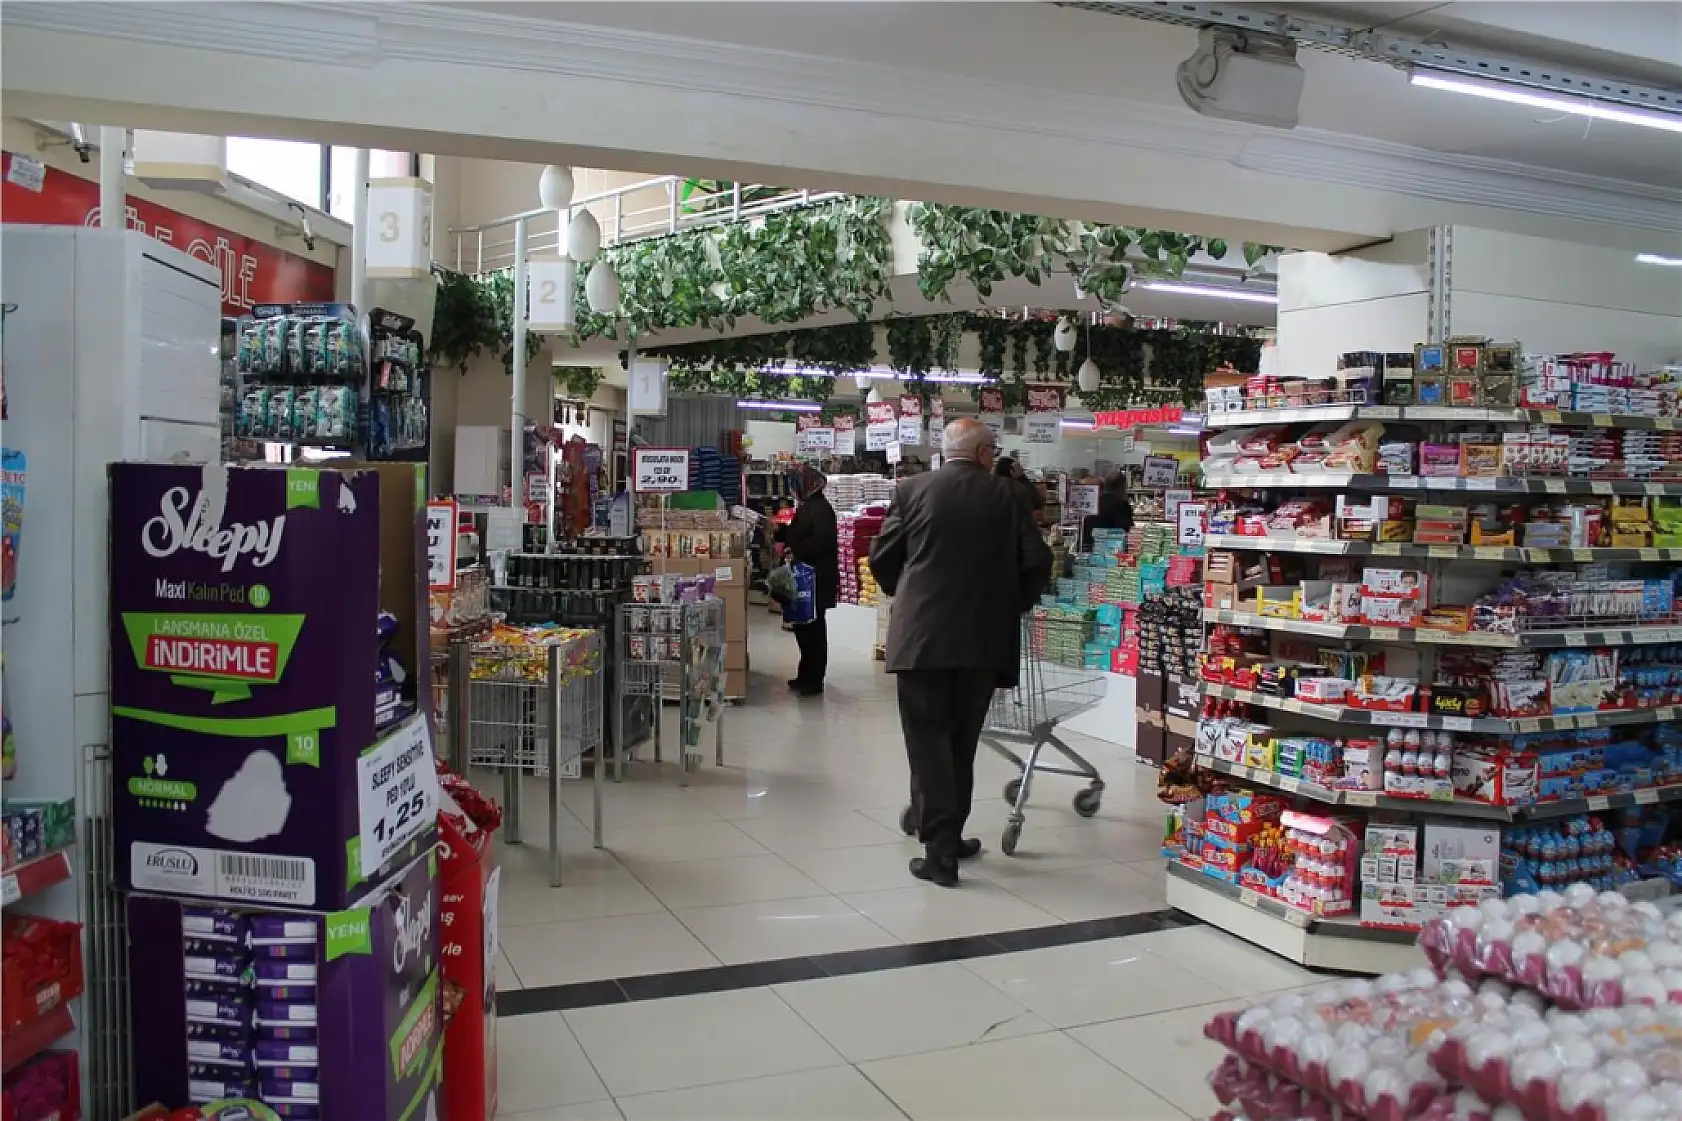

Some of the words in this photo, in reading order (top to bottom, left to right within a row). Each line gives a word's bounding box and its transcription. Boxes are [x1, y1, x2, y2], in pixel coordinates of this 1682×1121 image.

[379, 211, 400, 242] 3
[540, 280, 557, 303] 2
[640, 380, 649, 395] 1
[155, 577, 186, 599] Maxi
[220, 582, 245, 604] Ped
[154, 619, 230, 638] LANSMANA
[233, 620, 270, 641] ÖZEL
[295, 736, 315, 750] 10
[137, 780, 188, 797] NORMAL
[372, 789, 425, 843] 1,25
